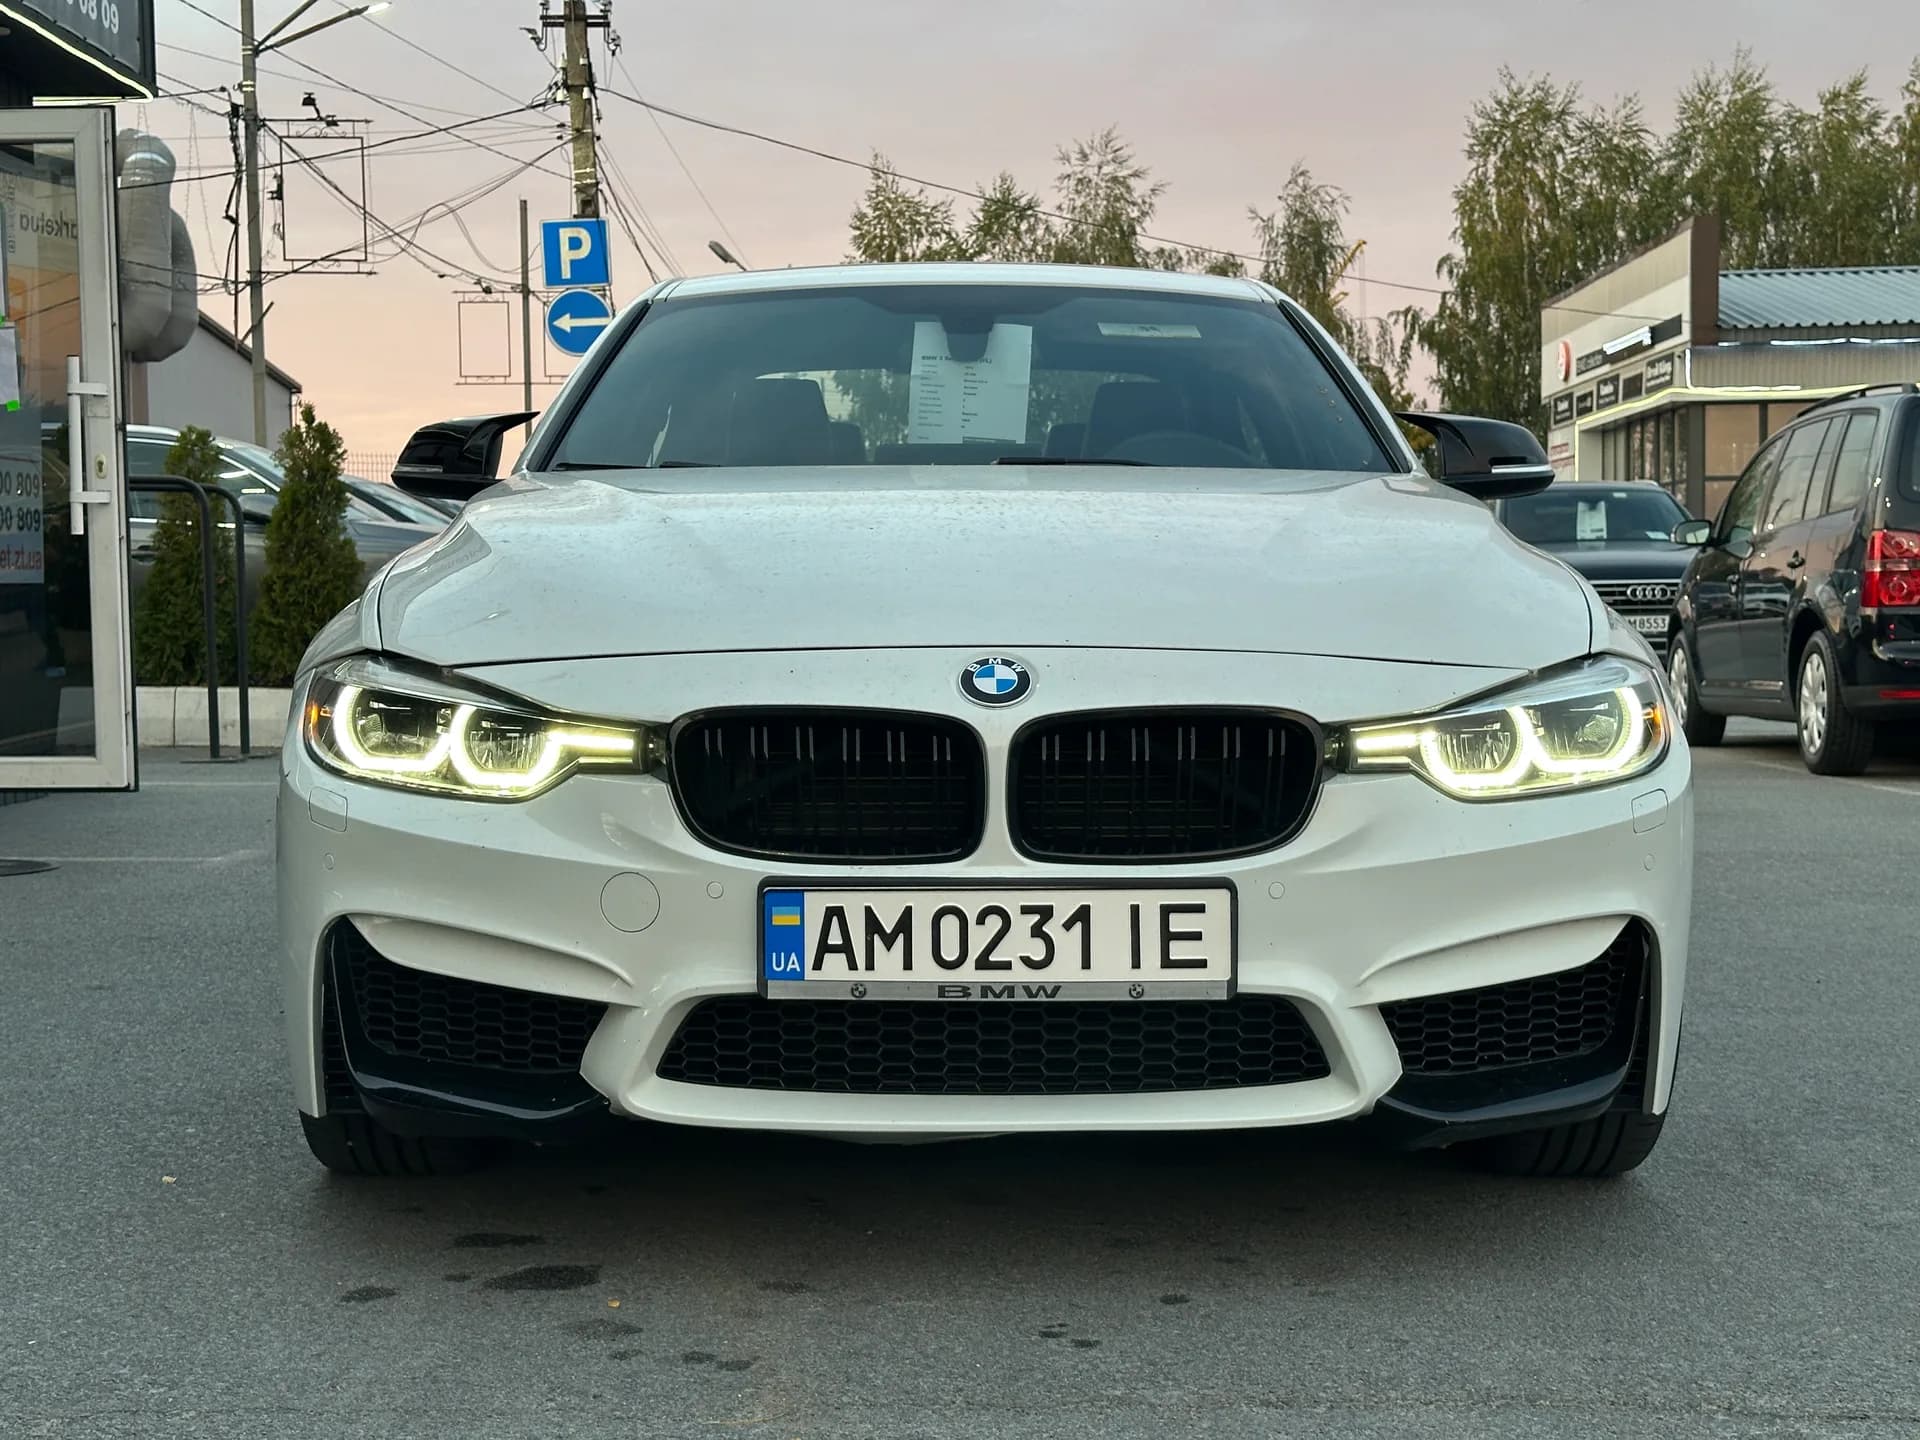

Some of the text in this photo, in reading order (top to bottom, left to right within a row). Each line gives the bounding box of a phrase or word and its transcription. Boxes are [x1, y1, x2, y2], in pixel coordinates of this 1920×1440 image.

[101, 3, 120, 34] 09
[559, 227, 592, 280] P
[17, 472, 40, 498] 809
[17, 506, 41, 532] 809
[966, 657, 1025, 673] BMW
[811, 903, 1209, 971] AM 0231 IE
[772, 951, 801, 972] UA
[937, 984, 1063, 999] BMW
